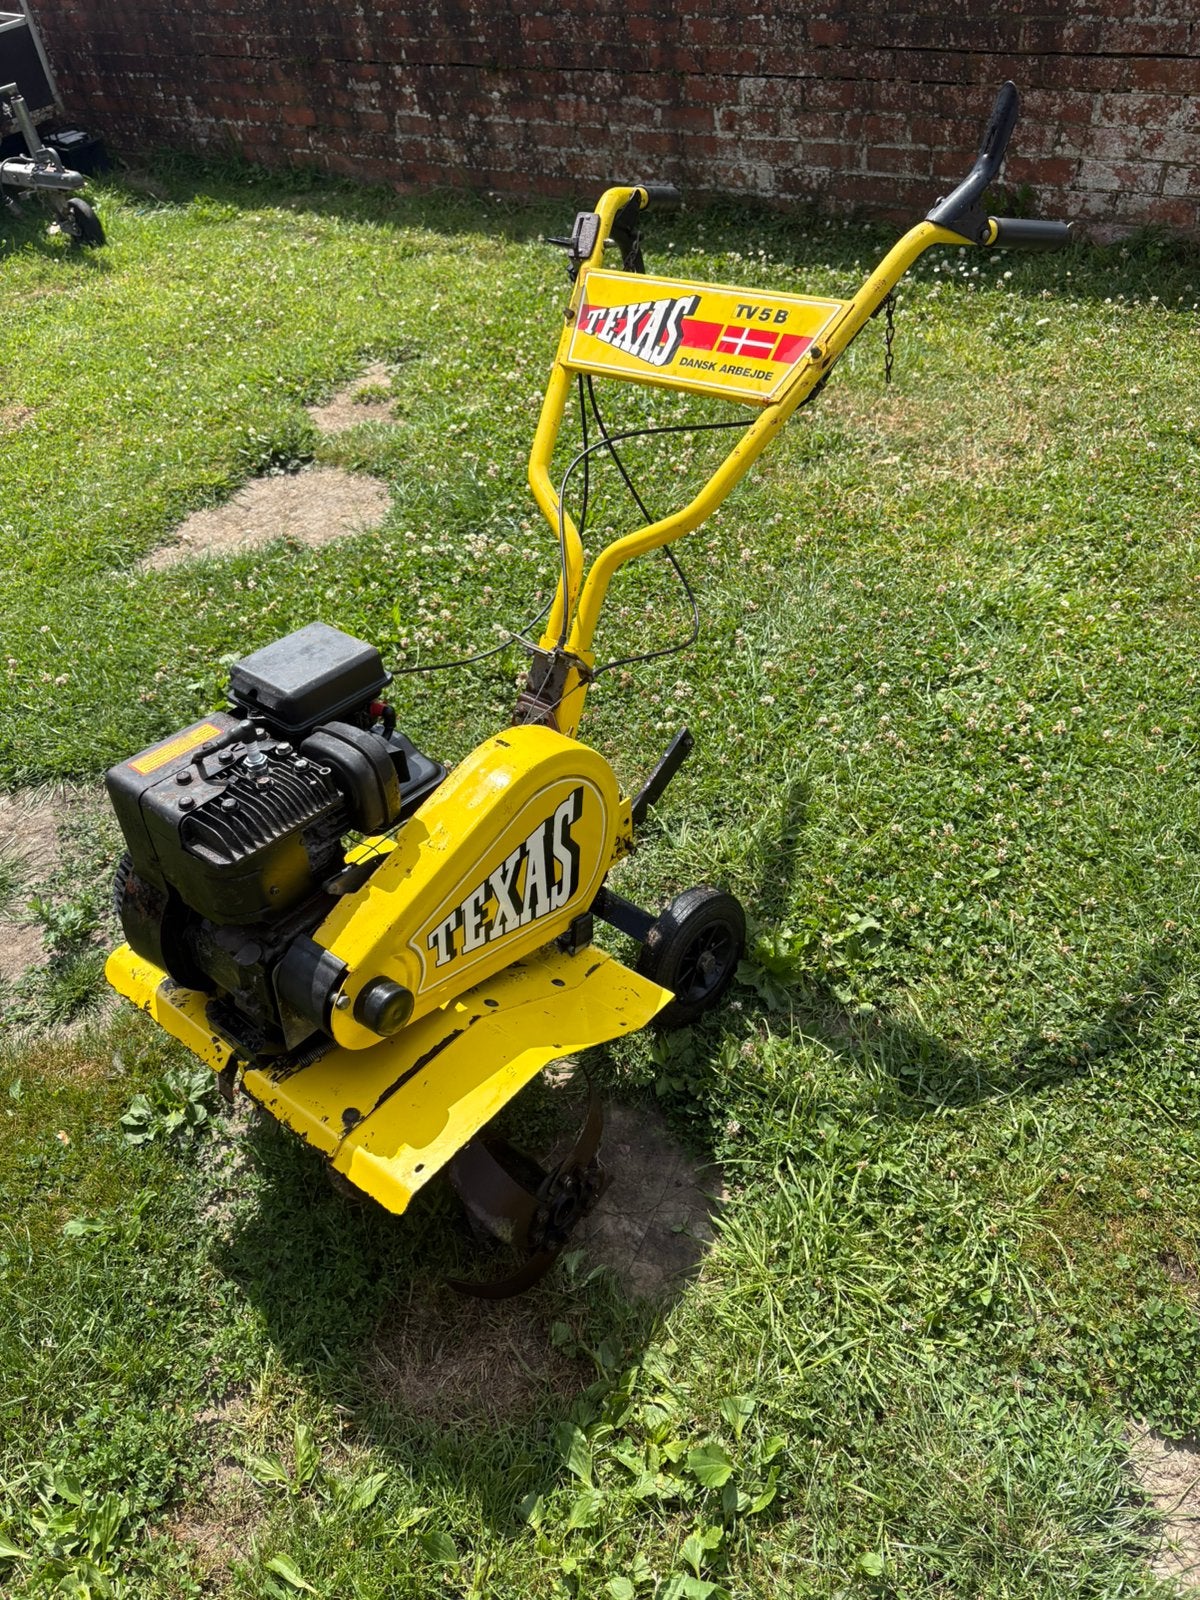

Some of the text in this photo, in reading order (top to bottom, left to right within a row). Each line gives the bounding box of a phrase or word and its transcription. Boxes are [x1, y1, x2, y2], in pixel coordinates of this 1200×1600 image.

[584, 294, 701, 367] TEXAS
[736, 304, 788, 324] TV 5 B
[679, 357, 774, 381] DANSK ARBEJDE
[427, 786, 583, 967] TEXAS
